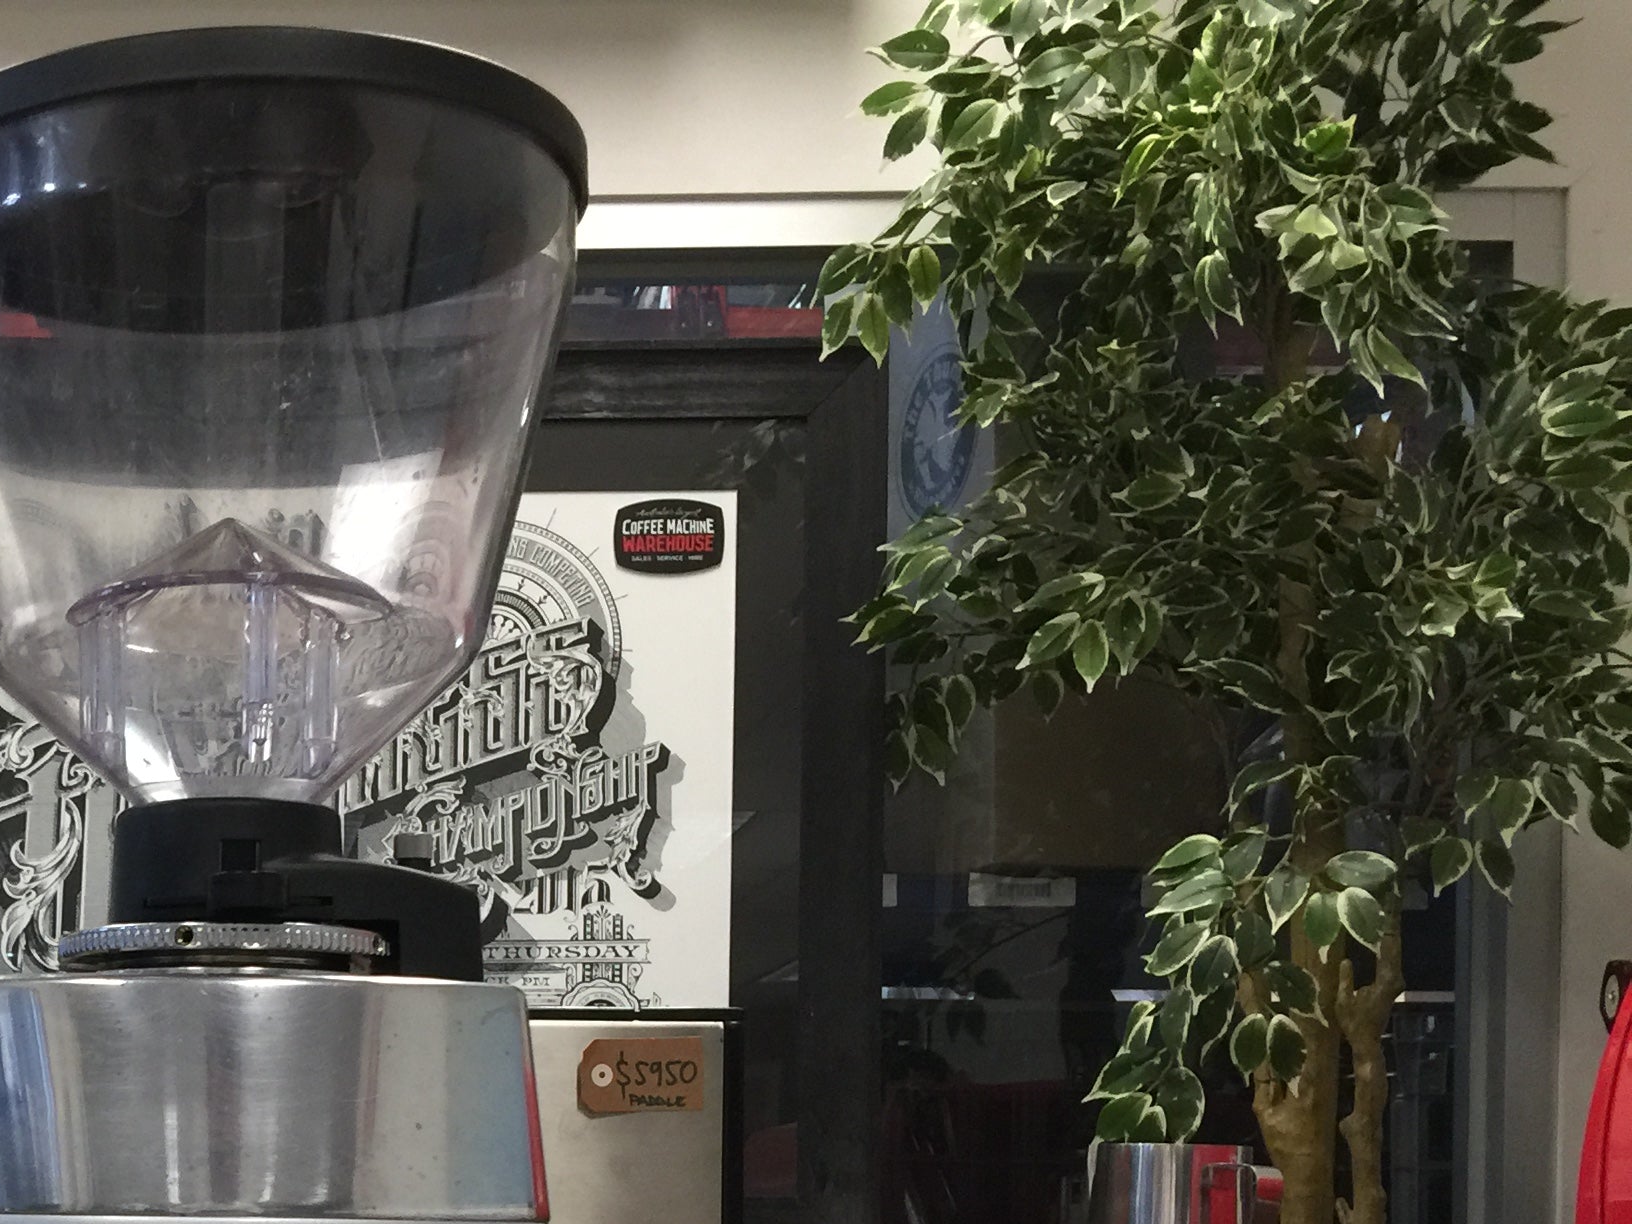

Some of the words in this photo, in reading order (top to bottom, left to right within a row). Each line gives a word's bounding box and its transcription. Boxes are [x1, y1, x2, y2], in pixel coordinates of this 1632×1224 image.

[622, 518, 665, 535] COFFEE
[666, 517, 715, 535] MACHINE
[622, 534, 714, 553] WAREHOUSE
[482, 944, 640, 960] THURSDAY
[615, 1050, 698, 1100] $5950
